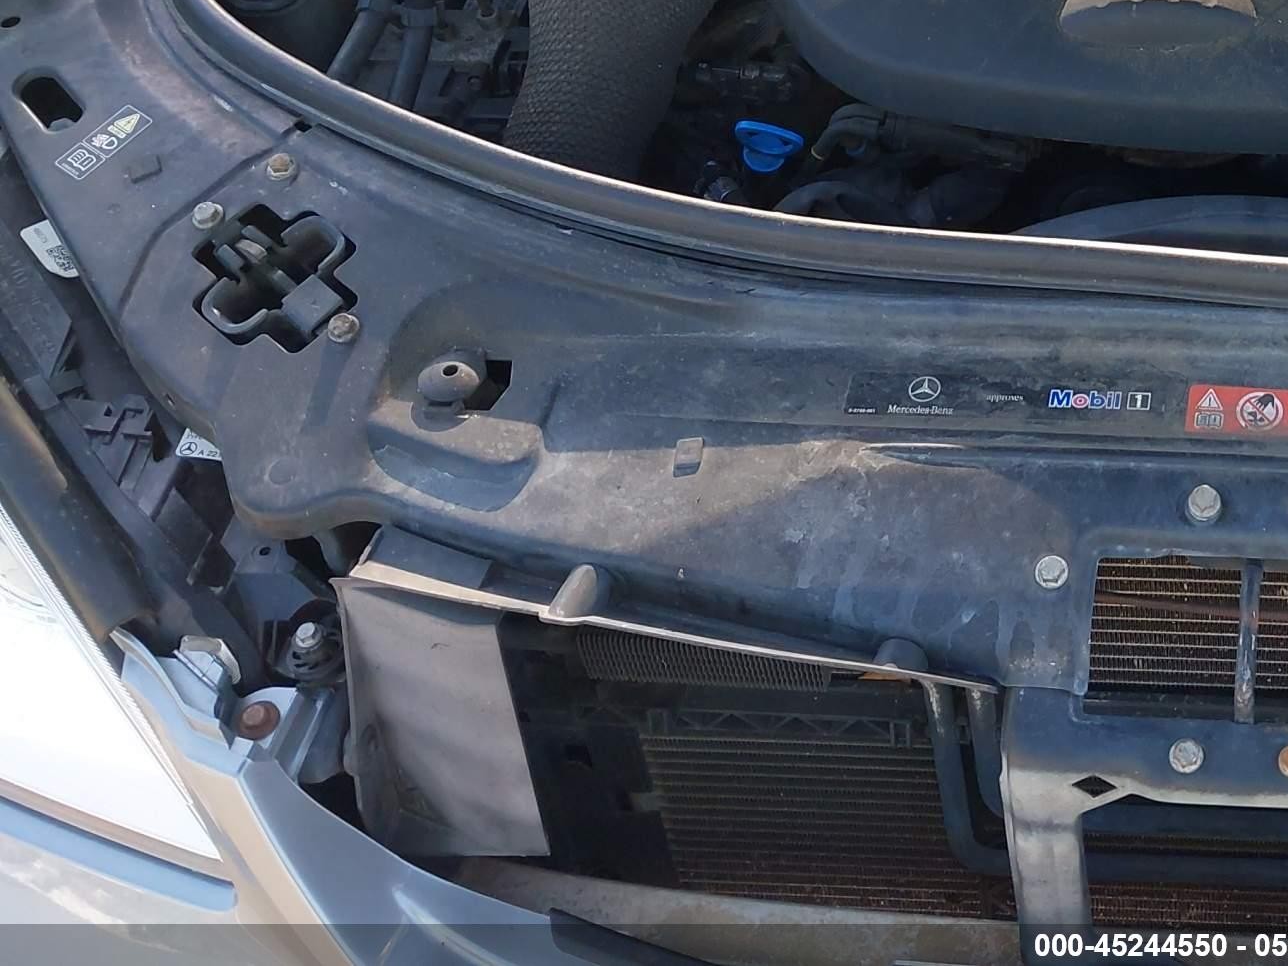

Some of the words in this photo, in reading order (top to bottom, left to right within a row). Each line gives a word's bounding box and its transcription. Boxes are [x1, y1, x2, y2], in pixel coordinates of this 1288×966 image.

[986, 394, 1024, 403] approves
[1048, 389, 1122, 410] Mobil
[887, 404, 954, 415] Mercedes-Benz
